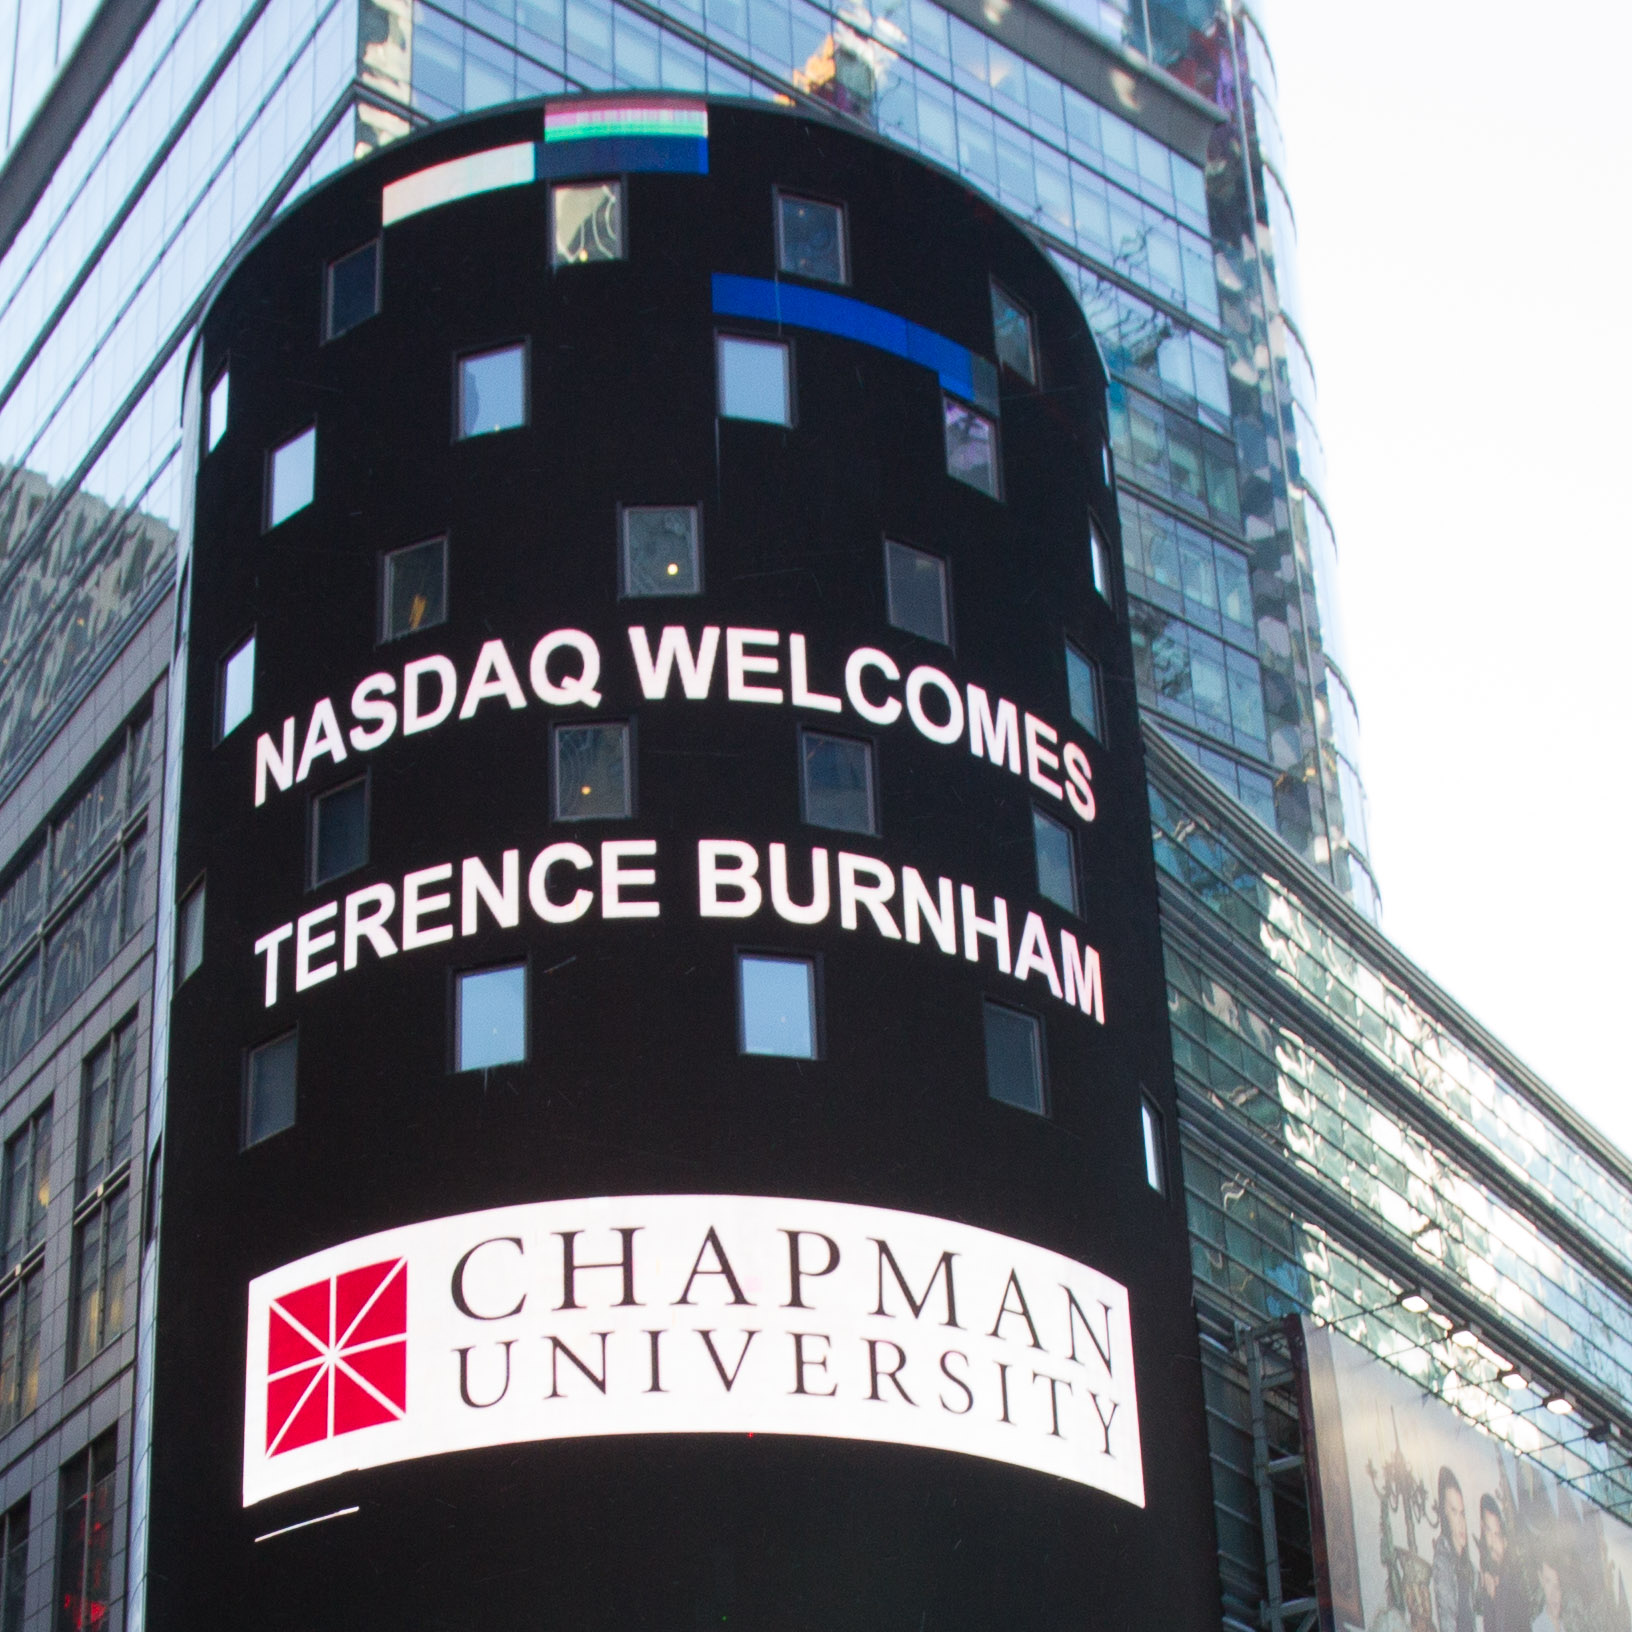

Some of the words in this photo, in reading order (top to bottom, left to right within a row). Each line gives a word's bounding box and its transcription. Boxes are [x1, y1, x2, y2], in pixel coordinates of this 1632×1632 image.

[254, 629, 601, 807] NASDAQ
[628, 626, 1097, 822] WELCOMES
[254, 840, 660, 1007] TERENCE
[698, 839, 1105, 1025] BURNHAM
[449, 1225, 1115, 1378] CHAPMAN
[449, 1328, 1121, 1460] UNIVERSITY
